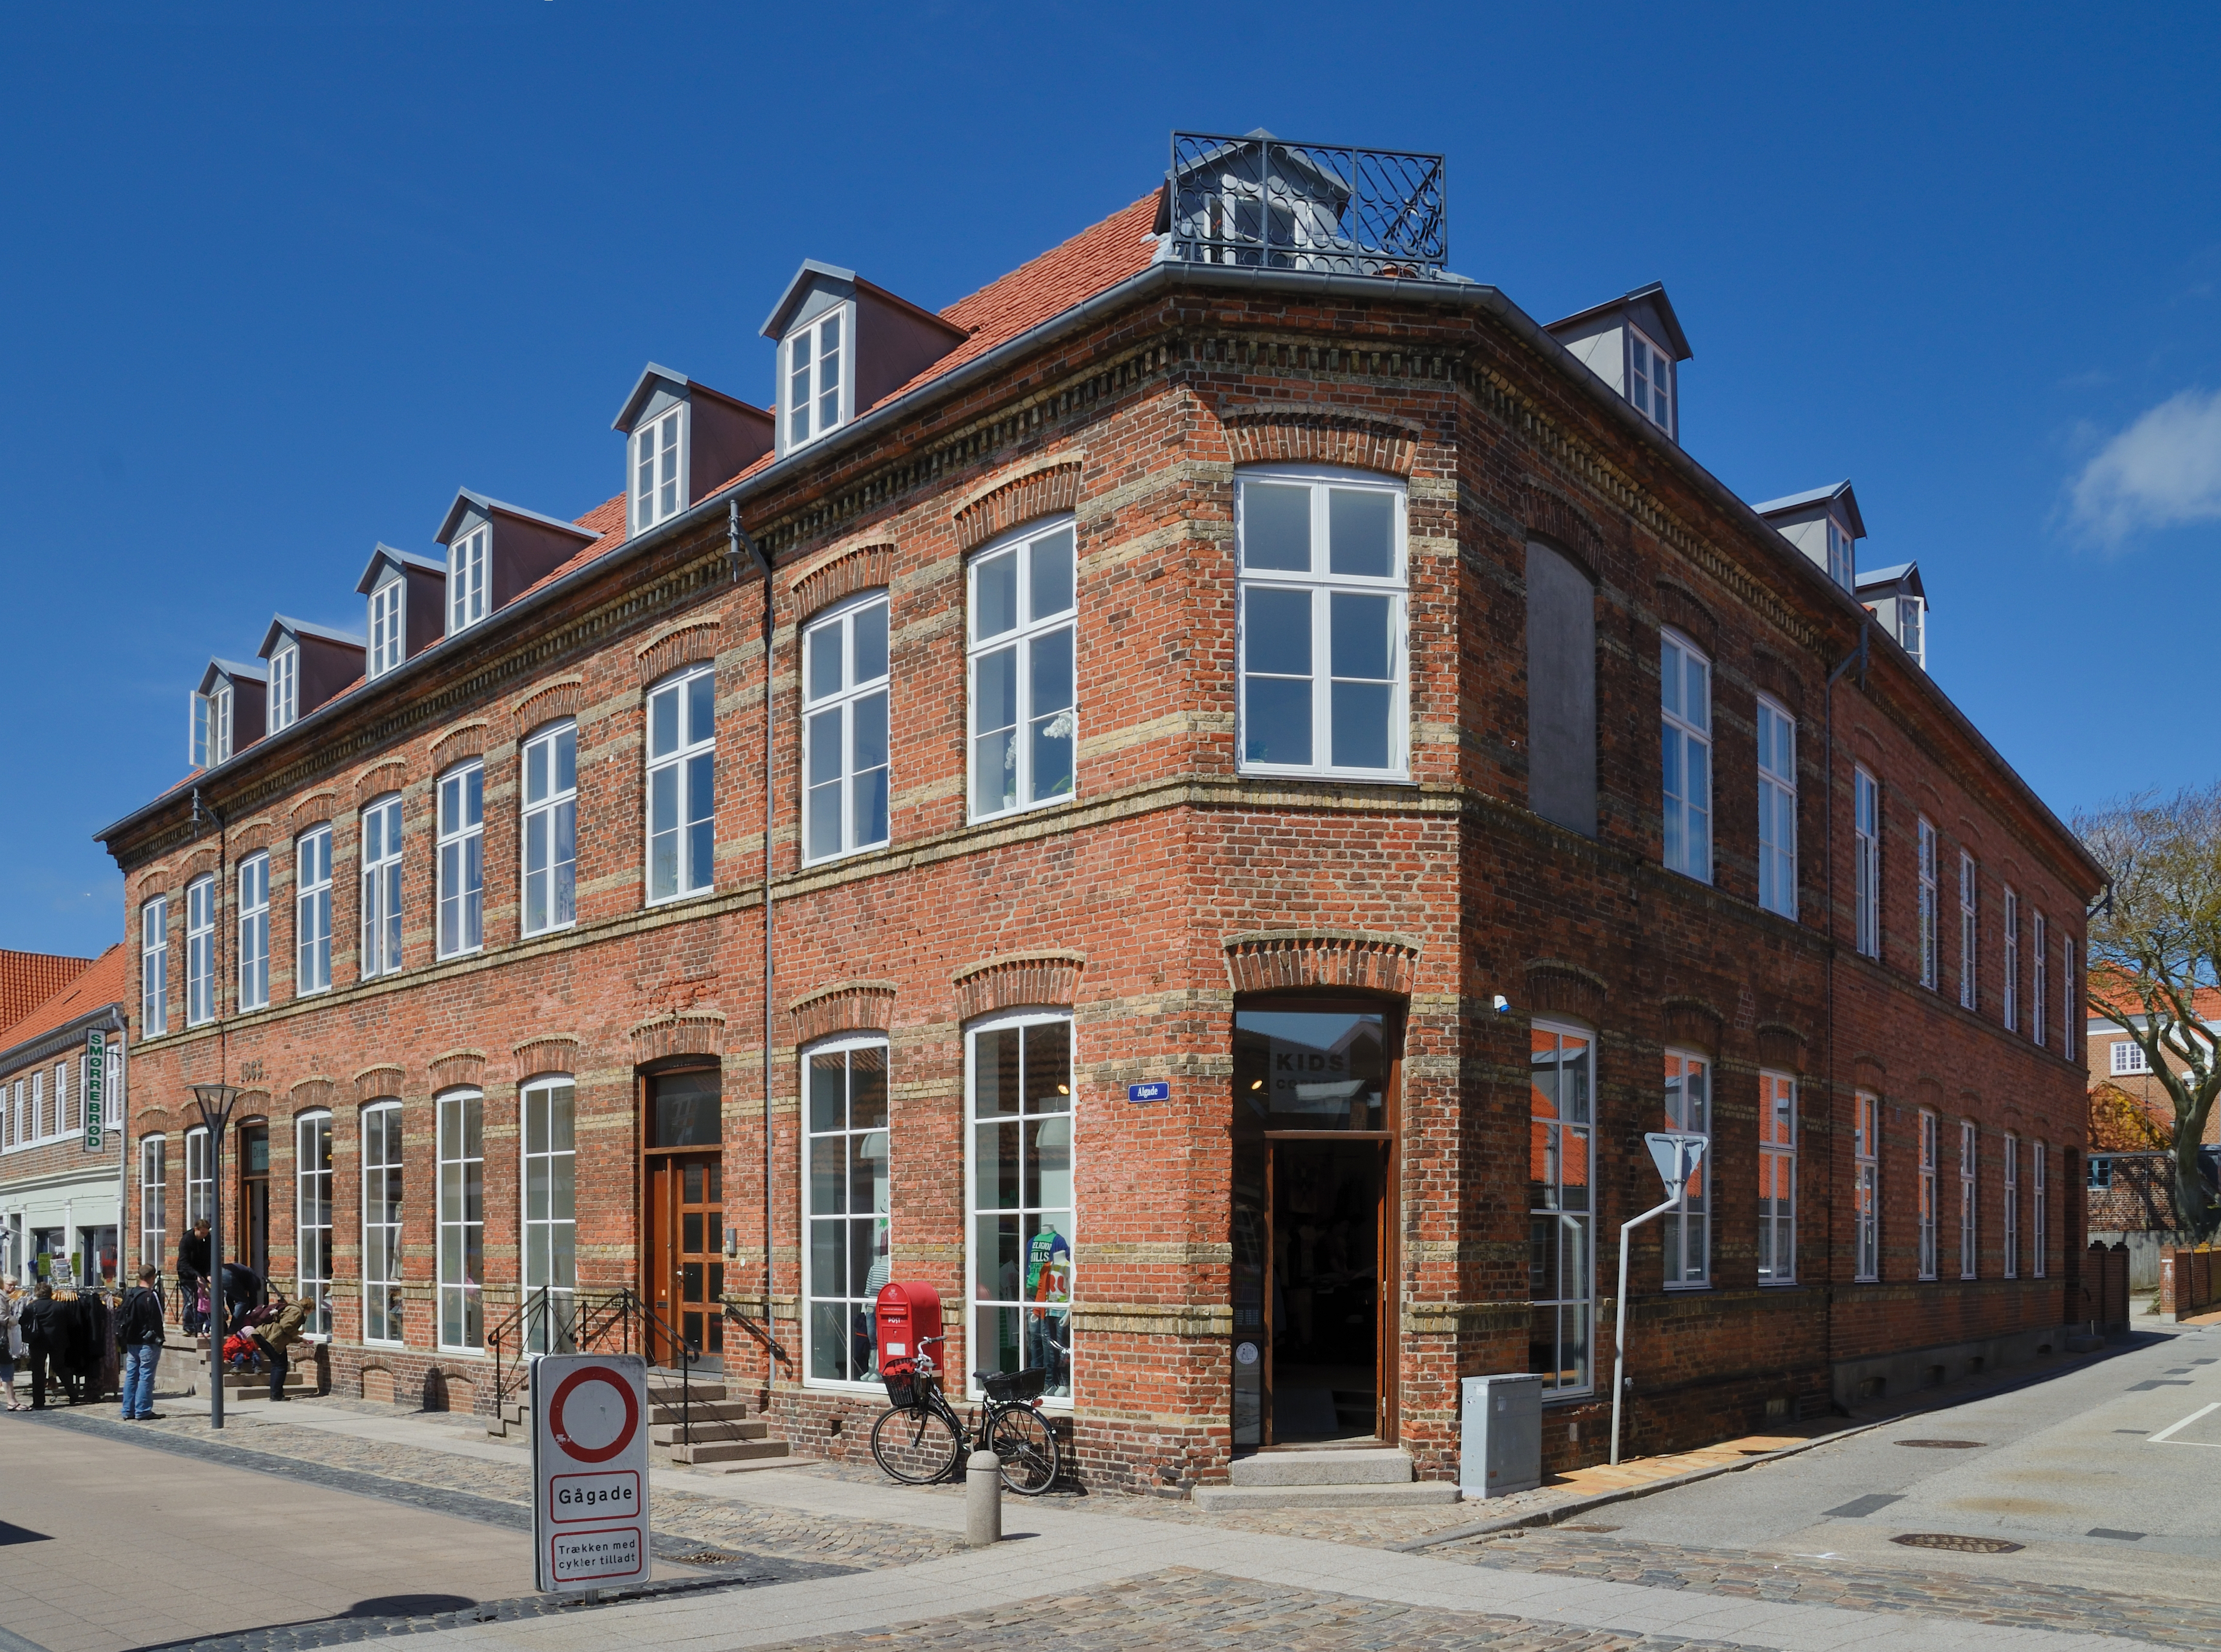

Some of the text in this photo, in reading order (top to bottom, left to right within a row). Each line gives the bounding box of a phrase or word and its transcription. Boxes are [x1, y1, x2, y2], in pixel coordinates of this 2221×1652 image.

[1277, 1053, 1344, 1072] KIDS
[88, 1034, 103, 1147] SMØRREBRØD
[1137, 1085, 1158, 1098] Algade
[559, 1485, 632, 1505] Gågade
[559, 1539, 635, 1555] Trækken med
[559, 1553, 635, 1570] cykler tilladt
